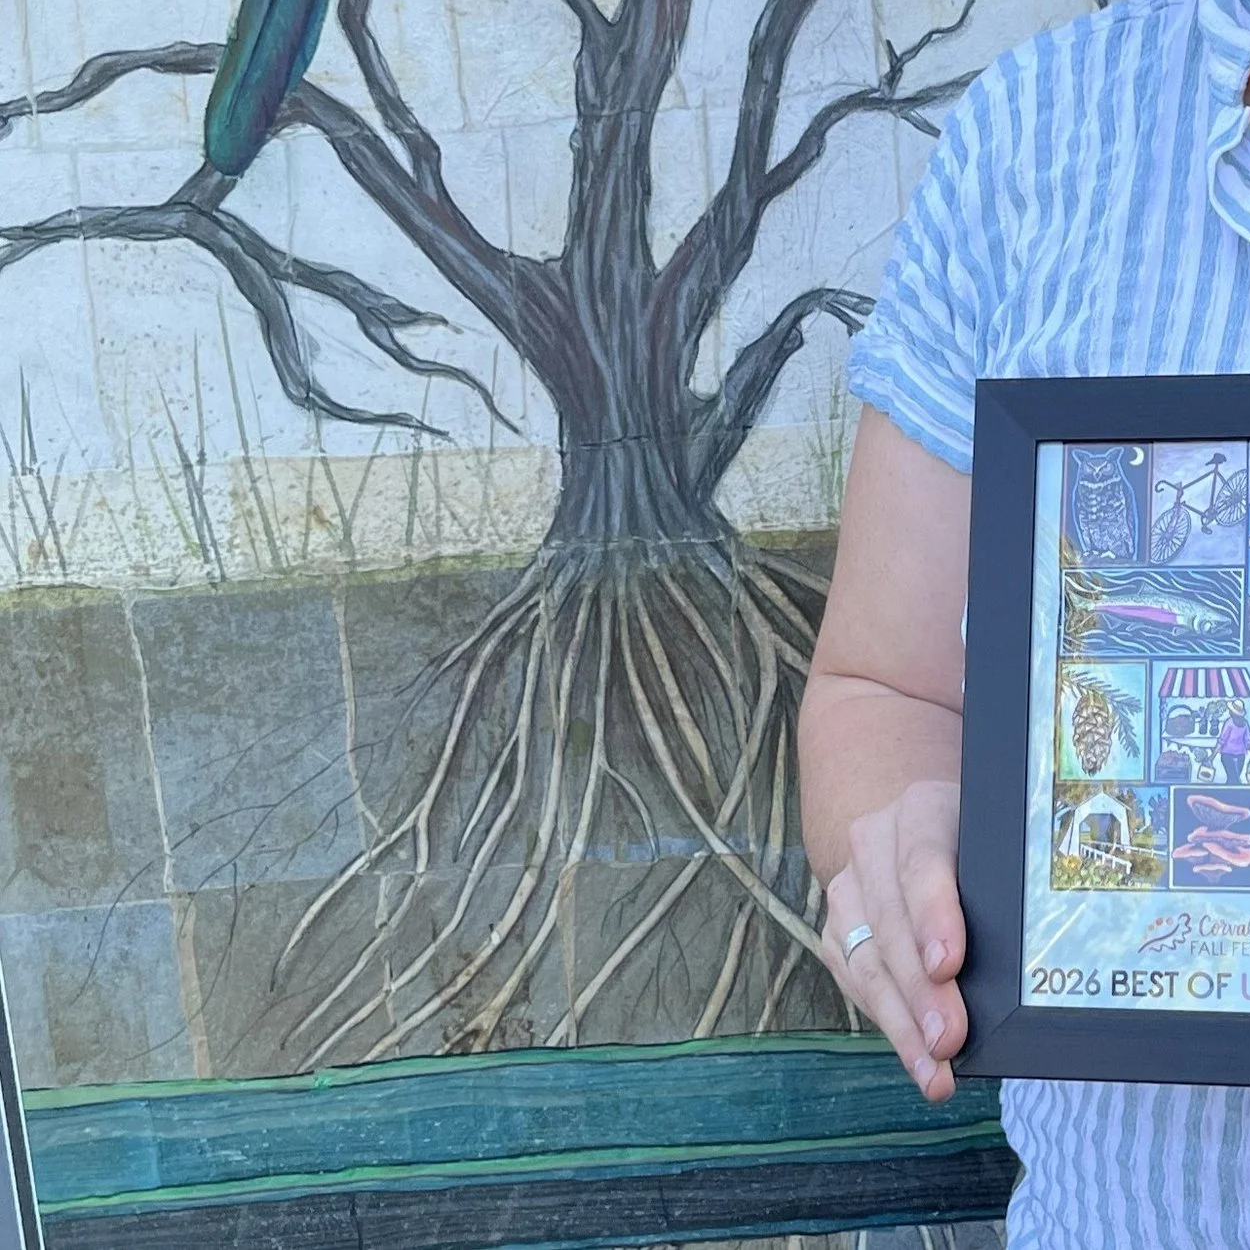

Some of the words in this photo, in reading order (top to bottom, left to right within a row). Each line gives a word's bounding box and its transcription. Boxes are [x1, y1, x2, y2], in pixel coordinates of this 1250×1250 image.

[1190, 940, 1228, 956] FALL
[1030, 967, 1101, 996] 2026
[1111, 970, 1180, 998] BEST
[1187, 970, 1233, 999] OF
